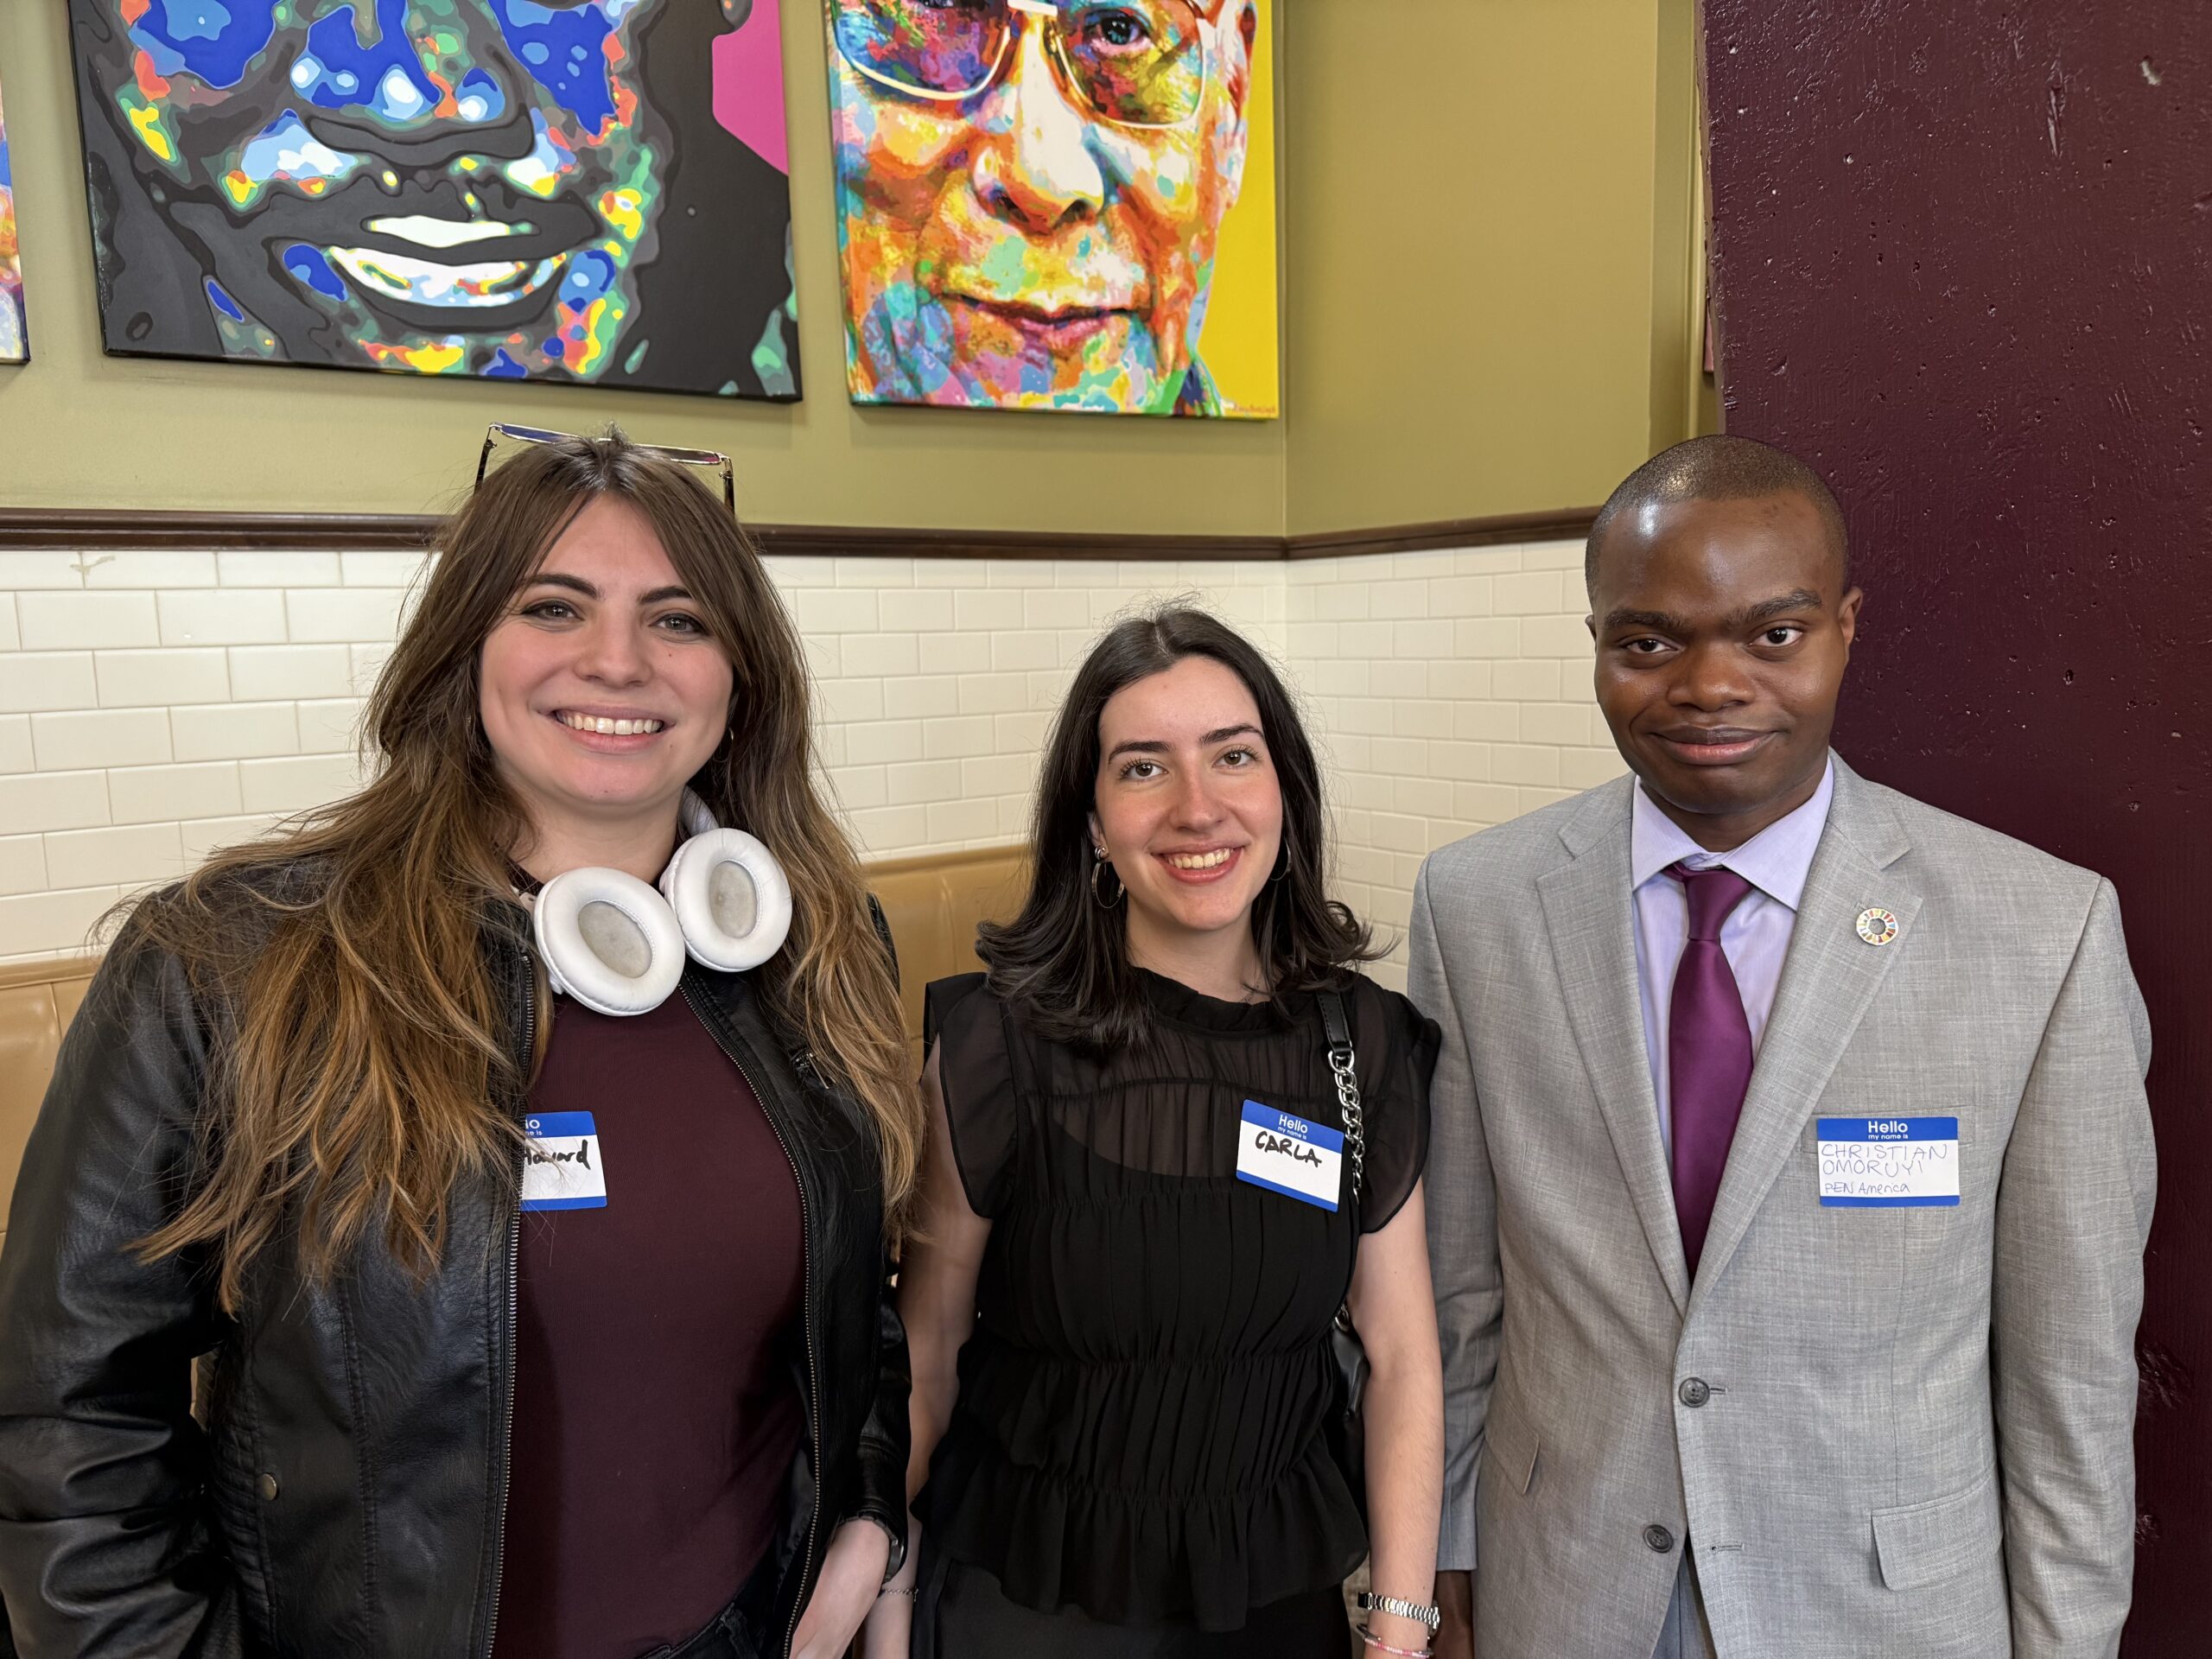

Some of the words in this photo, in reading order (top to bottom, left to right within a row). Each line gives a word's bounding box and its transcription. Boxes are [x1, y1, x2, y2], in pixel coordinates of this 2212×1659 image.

[1279, 1115, 1308, 1133] Hello
[1868, 1121, 1908, 1133] Hello
[1287, 1129, 1302, 1138] name
[1255, 1131, 1322, 1167] CARLA
[1821, 1143, 1948, 1161] CHRISTIAN
[1822, 1159, 1923, 1178] OMORUYI
[1824, 1181, 1854, 1195] PEN
[1858, 1181, 1910, 1196] America
